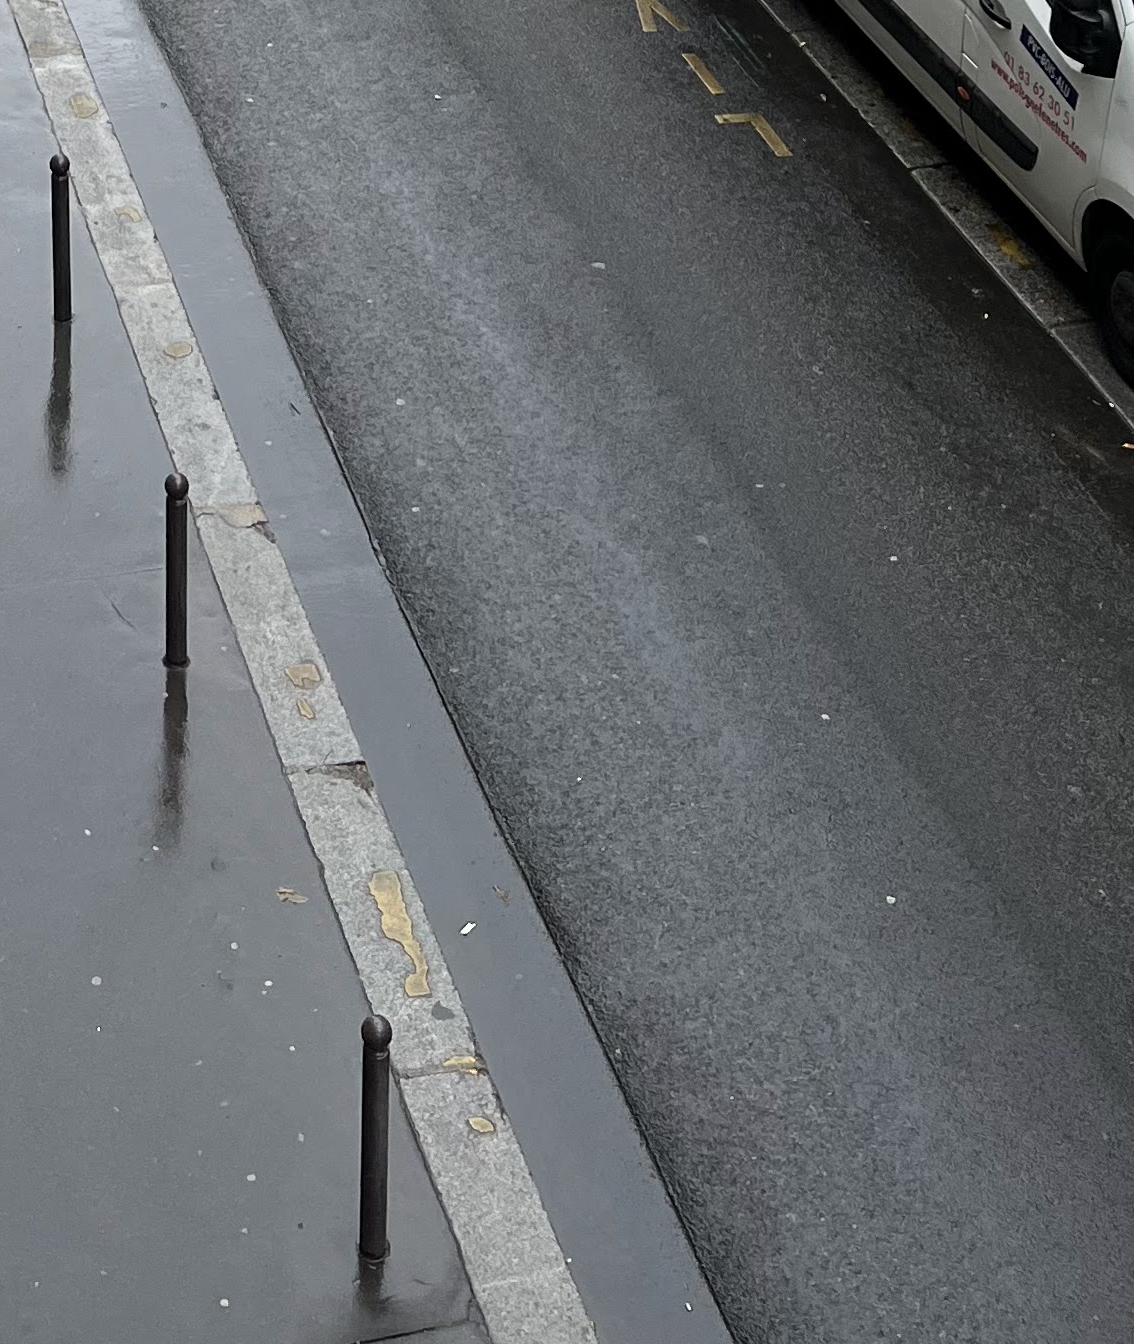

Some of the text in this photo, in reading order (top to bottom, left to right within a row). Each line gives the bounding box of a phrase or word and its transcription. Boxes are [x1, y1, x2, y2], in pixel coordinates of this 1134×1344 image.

[1004, 51, 1075, 131] 01 83 62 30 51
[1027, 35, 1071, 99] PVC-BOIS-ALU
